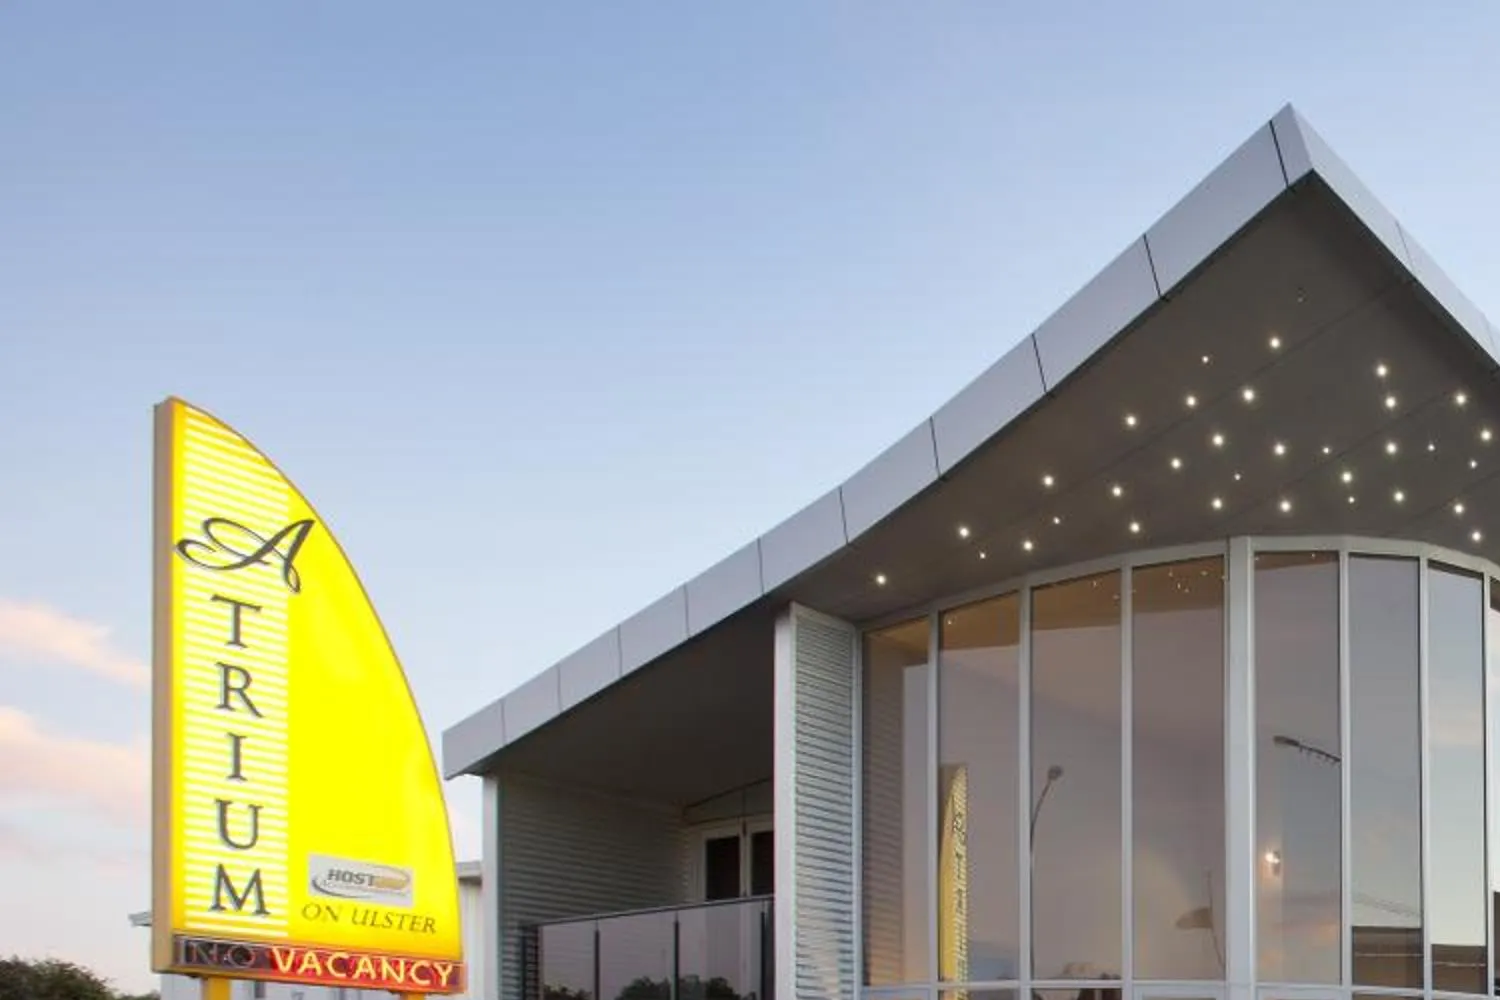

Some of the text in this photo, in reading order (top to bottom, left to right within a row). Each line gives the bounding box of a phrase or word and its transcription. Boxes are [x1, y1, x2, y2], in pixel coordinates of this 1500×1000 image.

[176, 517, 316, 917] ATRIUM
[327, 868, 376, 887] HOST
[302, 902, 438, 935] ON ULSTER
[272, 945, 454, 987] VACANCY
